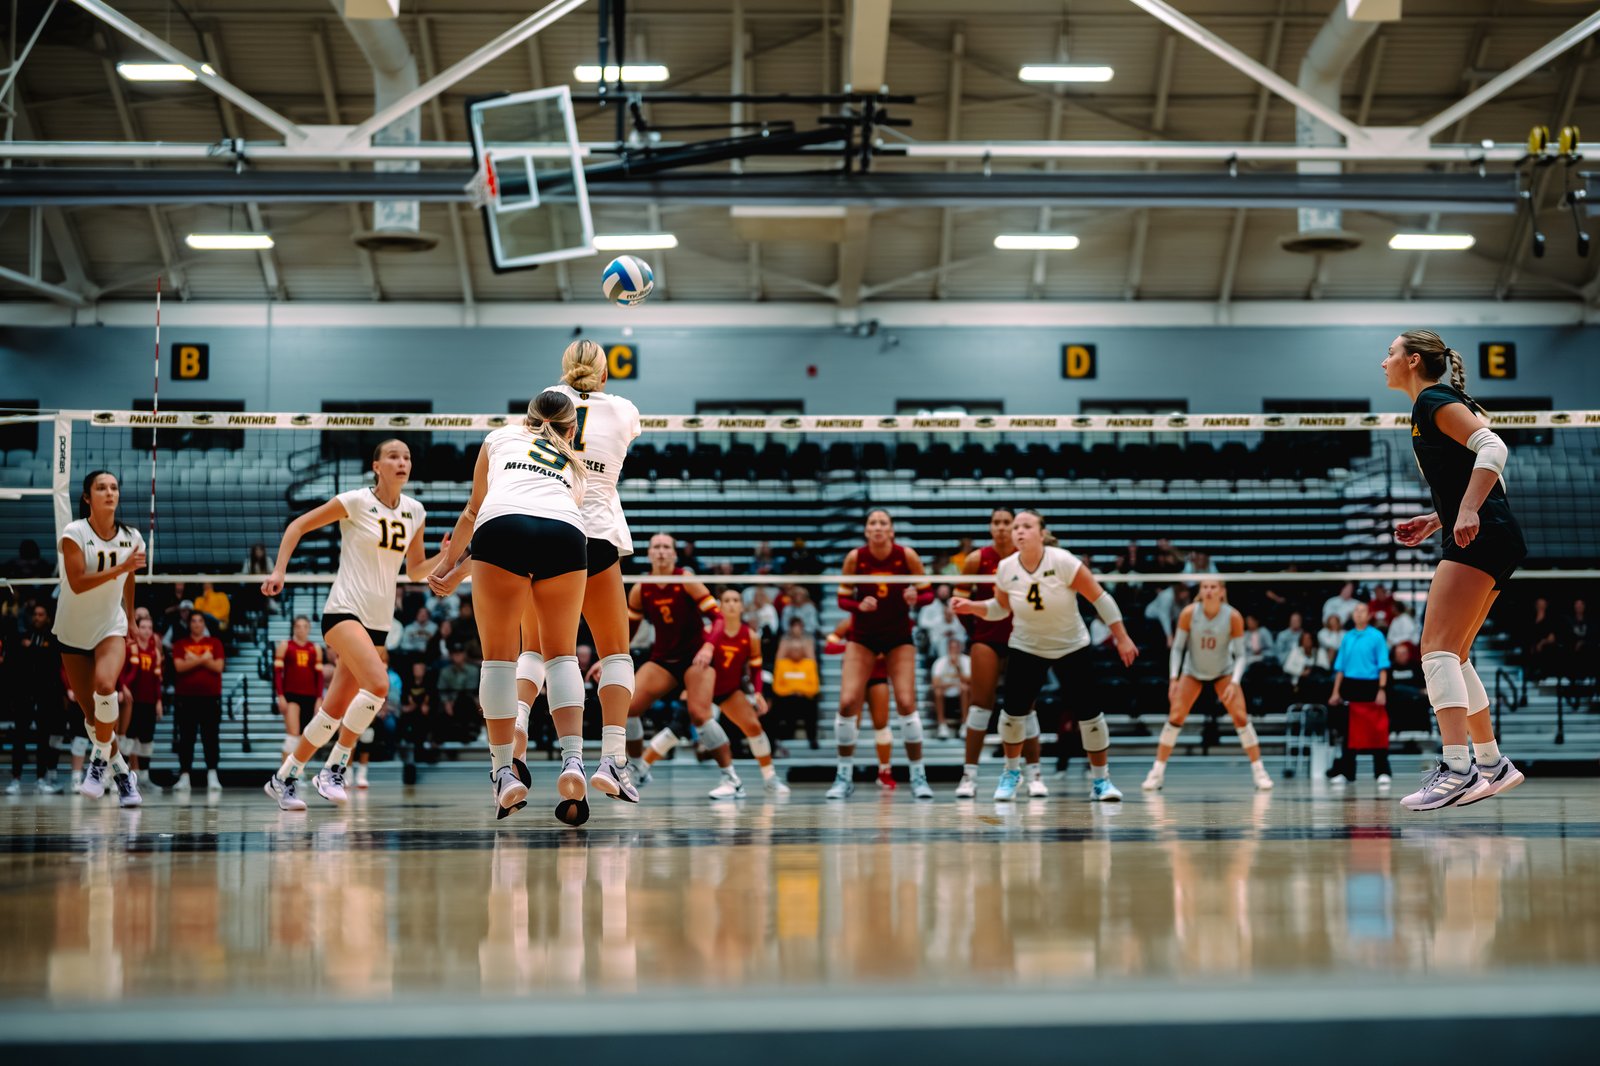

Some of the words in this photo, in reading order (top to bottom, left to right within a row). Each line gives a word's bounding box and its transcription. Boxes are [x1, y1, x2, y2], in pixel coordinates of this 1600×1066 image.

[180, 346, 200, 378] B
[607, 345, 633, 379] C
[1066, 345, 1091, 378] D
[1487, 344, 1506, 378] E
[129, 415, 178, 424] PANTHERS
[228, 415, 277, 425] PANTHERS
[326, 416, 375, 426] PANTHERS
[424, 417, 473, 427] PANTHERS
[640, 418, 668, 428] THERS
[717, 418, 766, 428] PANTHERS
[815, 419, 863, 429] PANTHERS
[912, 419, 961, 429] PANTHERS
[1009, 419, 1058, 428] PANTHERS
[1106, 418, 1154, 428] PANTHERS
[1203, 417, 1250, 426] PANTHERS
[1298, 416, 1346, 426] PANTHERS
[1490, 415, 1537, 425] PANTHERS
[378, 518, 406, 553] 12
[97, 551, 117, 574] 11
[1027, 582, 1044, 611] 4
[660, 605, 673, 624] 2
[1201, 636, 1216, 650] 10
[724, 651, 735, 668] 7
